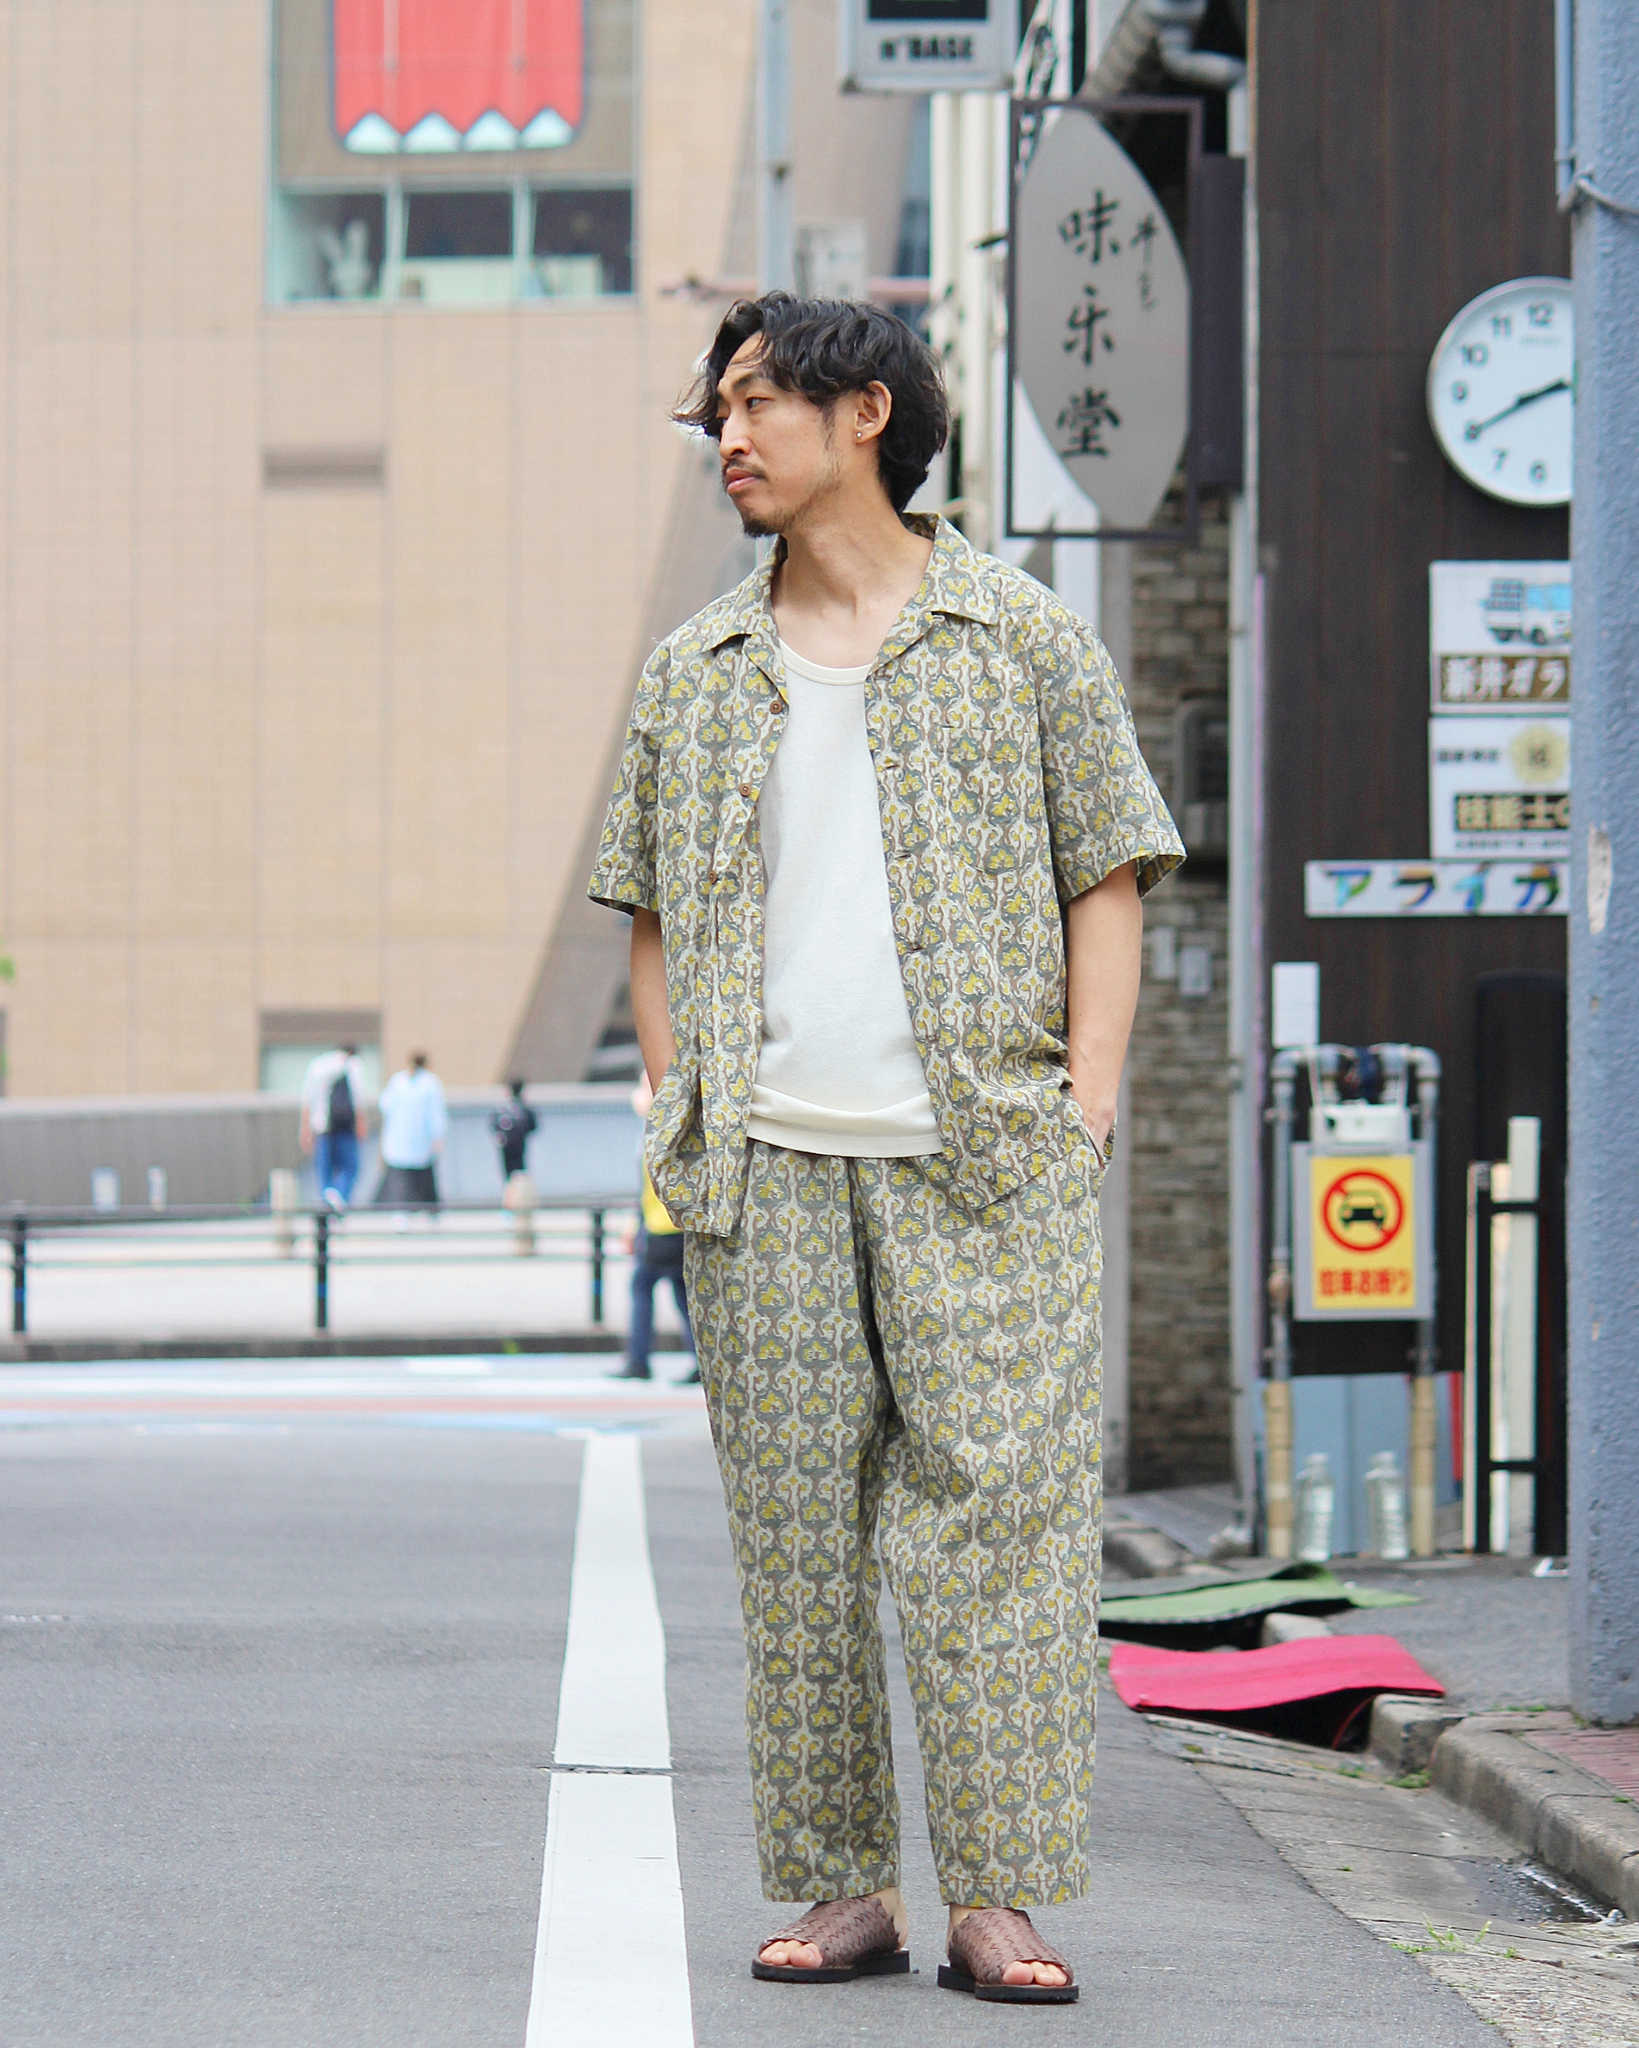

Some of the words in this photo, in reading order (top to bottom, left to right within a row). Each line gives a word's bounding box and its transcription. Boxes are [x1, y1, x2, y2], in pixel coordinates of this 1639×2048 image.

[1492, 315, 1512, 337] 11
[1528, 303, 1553, 326] 12
[1462, 344, 1489, 367] 10
[1452, 381, 1468, 404] 9
[1493, 449, 1508, 472] 7
[1530, 460, 1548, 483] 6
